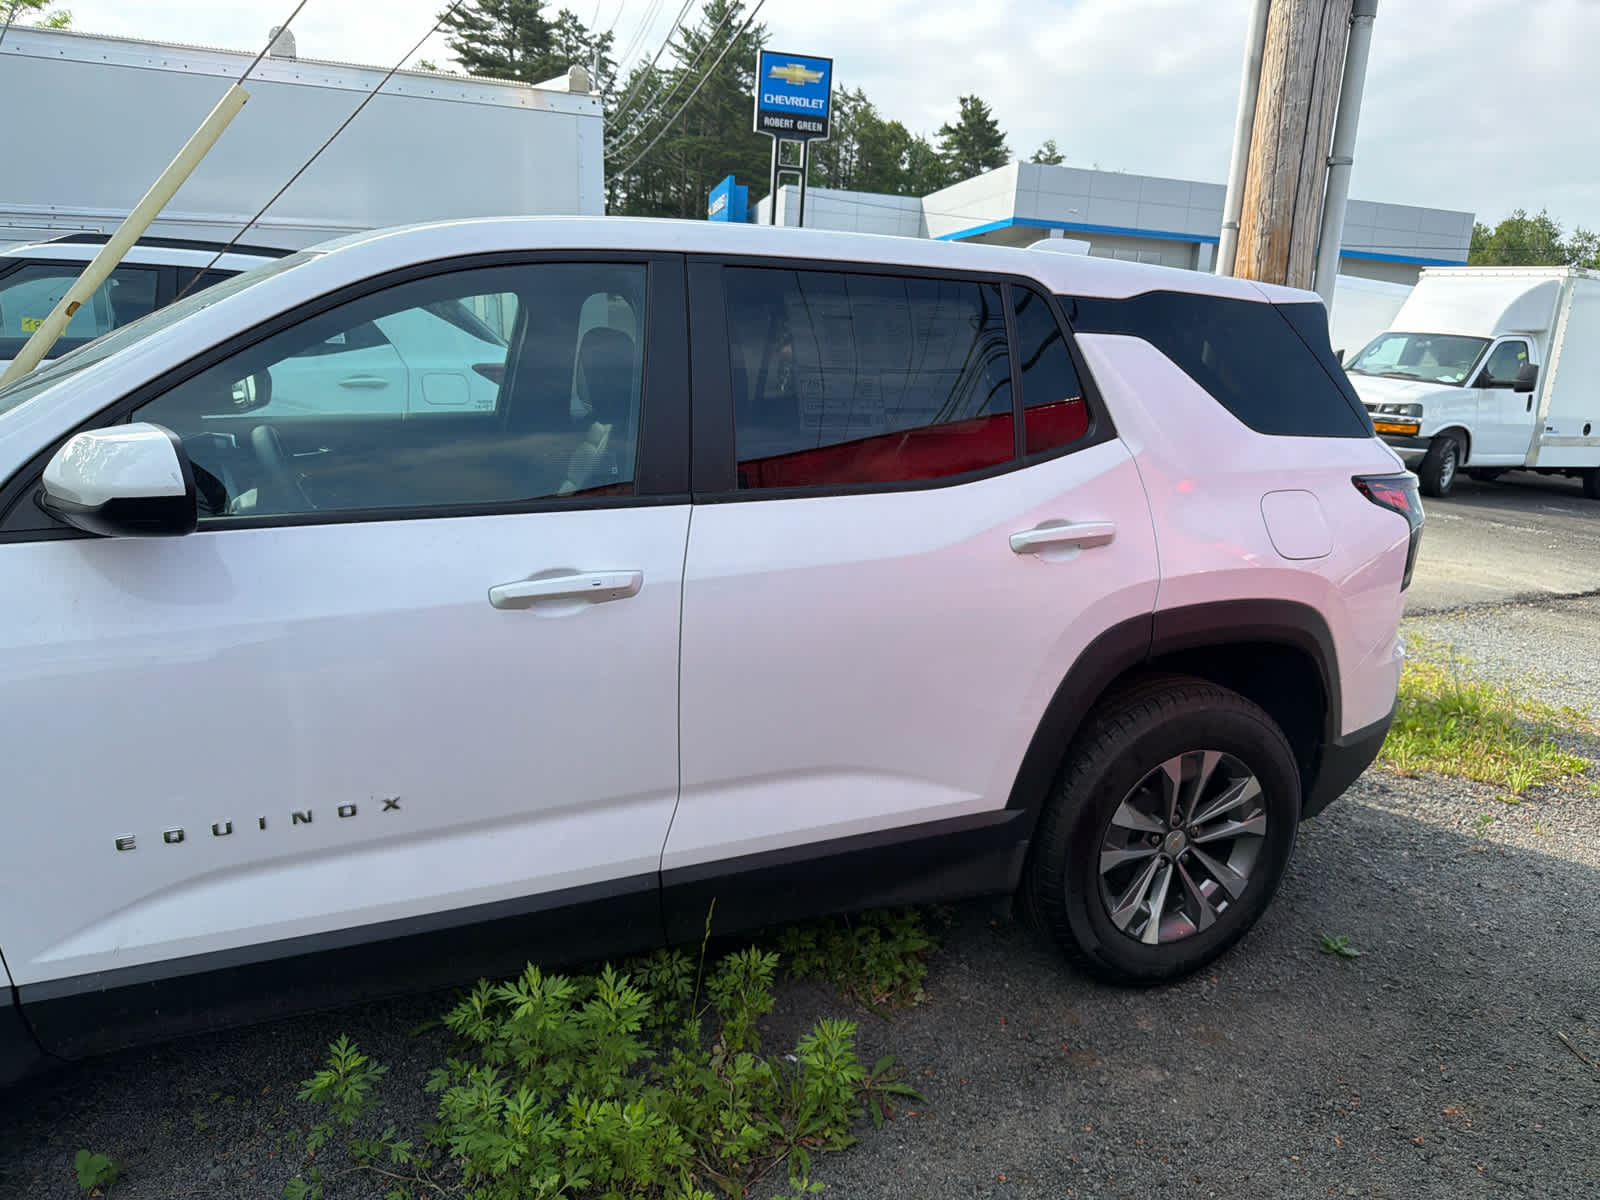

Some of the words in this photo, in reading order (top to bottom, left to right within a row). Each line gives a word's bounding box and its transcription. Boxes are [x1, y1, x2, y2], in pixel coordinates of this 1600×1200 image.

[764, 93, 824, 109] CHEVROLET
[764, 117, 793, 129] ROBERT
[797, 120, 823, 132] GREEN
[114, 796, 402, 851] EQUINOX
